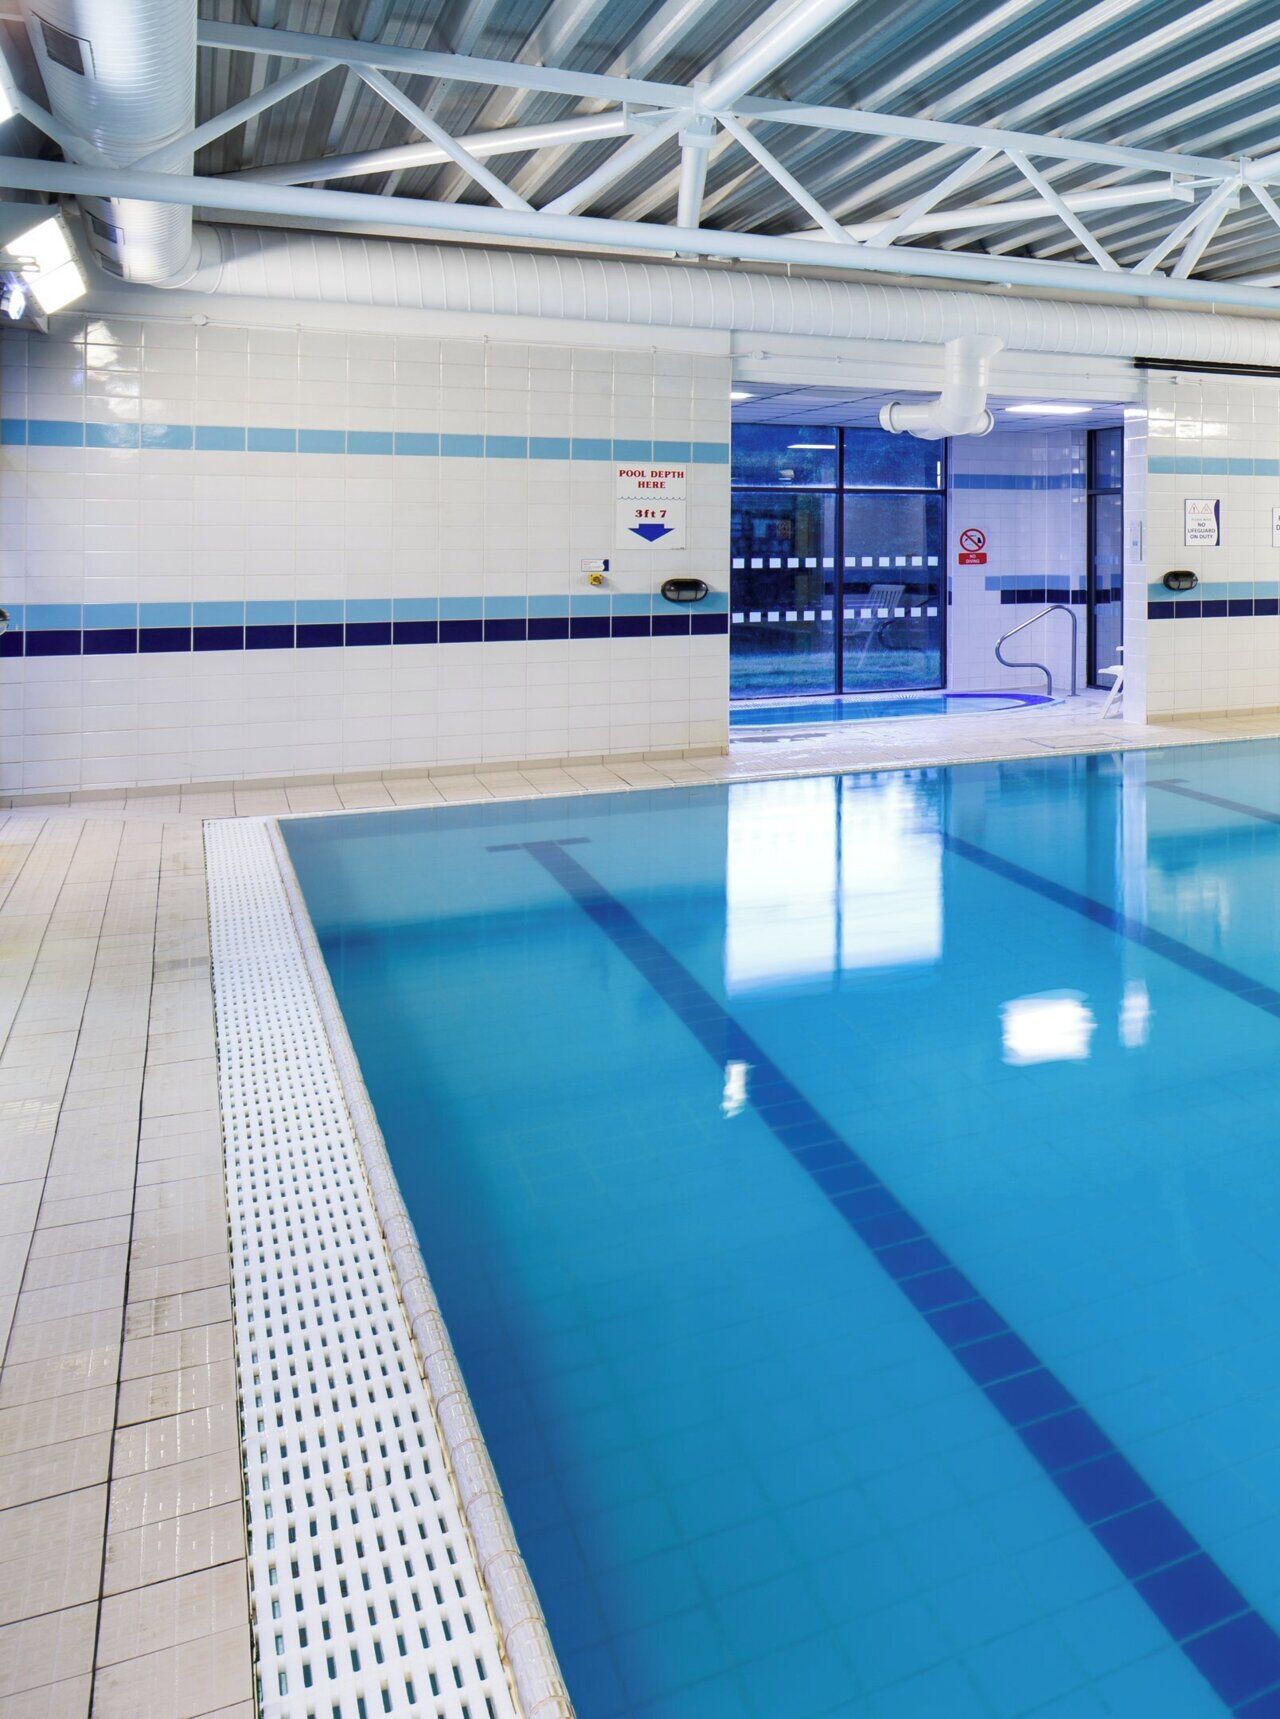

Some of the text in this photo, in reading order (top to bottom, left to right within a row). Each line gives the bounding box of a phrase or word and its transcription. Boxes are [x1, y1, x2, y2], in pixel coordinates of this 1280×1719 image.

[618, 470, 684, 478] POOL DEPTH
[638, 481, 666, 489] HERE
[659, 510, 668, 518] 7
